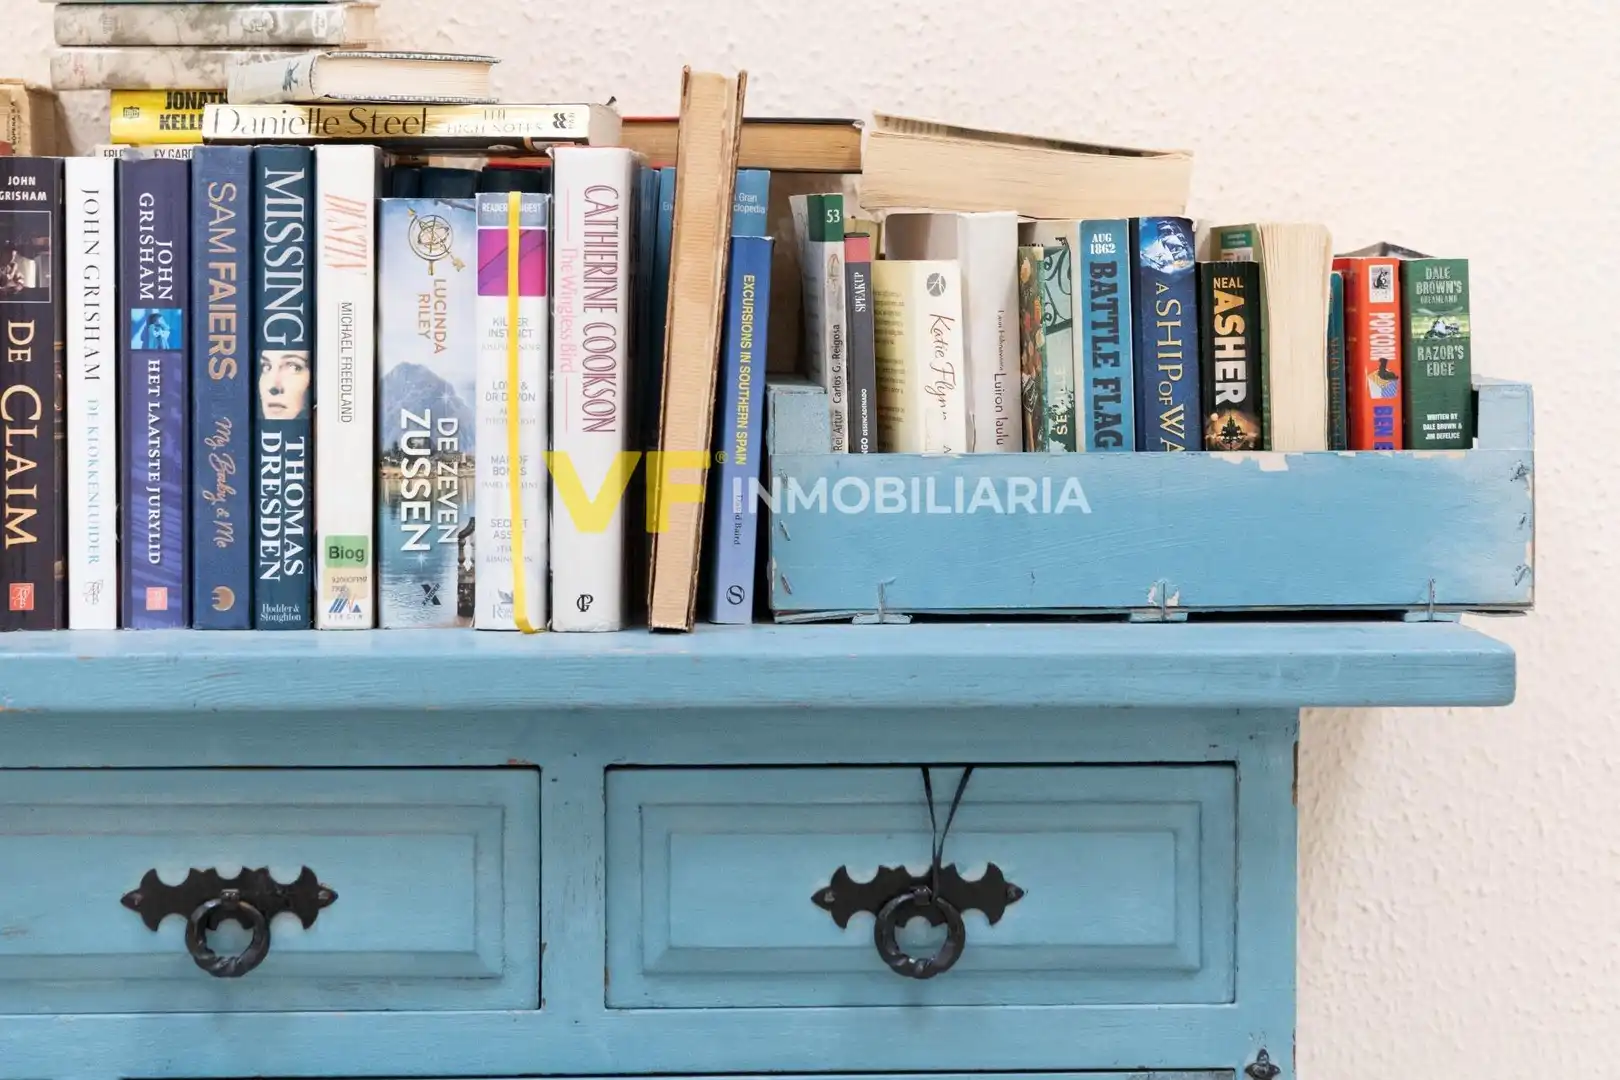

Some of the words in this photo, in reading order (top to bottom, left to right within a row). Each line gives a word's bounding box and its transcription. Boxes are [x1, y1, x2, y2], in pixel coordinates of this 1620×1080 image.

[213, 107, 341, 135] Danielle
[348, 107, 428, 134] Steel
[0, 191, 47, 201] GRISHAM
[8, 176, 36, 186] JOHN
[739, 193, 757, 203] Gran
[81, 190, 100, 255] JOHN
[208, 182, 237, 253] SAM
[826, 209, 840, 223] 53
[139, 193, 154, 300] GRISHAM
[583, 184, 619, 313] CATHERINE
[1090, 243, 1116, 254] 1862
[1091, 233, 1111, 243] AUG
[155, 241, 173, 300] JOHN
[263, 168, 305, 345] MISSING
[559, 247, 578, 269] The
[1425, 266, 1451, 280] DALE
[854, 272, 866, 312] SPEAKUP
[1155, 282, 1169, 295] A
[1213, 277, 1244, 289] NEAL
[1416, 280, 1463, 295] BROWN'S
[84, 265, 101, 381] GRISHAM
[208, 262, 237, 380] FAIERS
[417, 294, 431, 340] RILEY
[433, 278, 447, 354] LUCINDA
[557, 276, 578, 340] Wingless
[740, 275, 755, 349] EXCURSIONS
[1089, 261, 1121, 369] BATTLE
[8, 320, 35, 363] DE
[341, 302, 353, 353] MICHAEL
[831, 324, 843, 360] Reigosa
[928, 314, 955, 358] Katie
[1156, 298, 1183, 381] SHIP
[1369, 312, 1396, 361] POPCORN
[560, 343, 578, 373] Bird
[739, 352, 752, 362] IN
[1213, 290, 1247, 405] ASHER
[1417, 345, 1464, 361] RAZOR'S
[147, 360, 160, 397] HET
[581, 322, 617, 433] COOKSON
[832, 362, 841, 373] G.
[1426, 361, 1455, 376] EDGE
[341, 356, 353, 423] FREEDLAND
[736, 365, 750, 428] SOUTHERN
[832, 375, 842, 404] Carlos
[994, 373, 1007, 413] Luiron
[1158, 381, 1173, 405] OF
[87, 399, 99, 419] DE
[832, 409, 843, 434] Artur
[1091, 378, 1124, 449] FLAG
[1373, 405, 1393, 437] BEN
[1426, 413, 1449, 421] WRITTEN
[147, 402, 161, 482] LAATSTE
[204, 417, 233, 450] My
[437, 417, 458, 452] DE
[735, 431, 747, 464] SPAIN
[832, 437, 842, 451] Rei
[995, 417, 1009, 445] laulu
[1436, 432, 1461, 440] DEFELICE
[1, 384, 42, 550] CLAIM
[203, 453, 236, 505] Baby
[401, 408, 431, 552] ZUSSEN
[87, 426, 100, 565] KLOKKENLUIDER
[216, 508, 230, 518] &
[260, 430, 282, 581] DRESDEN
[284, 437, 305, 575] THOMAS
[437, 461, 458, 544] ZEVEN
[146, 487, 161, 565] JURYLID
[213, 520, 234, 548] Me
[733, 522, 743, 545] Baird
[329, 546, 364, 562] Biog
[260, 612, 301, 622] Stoughton
